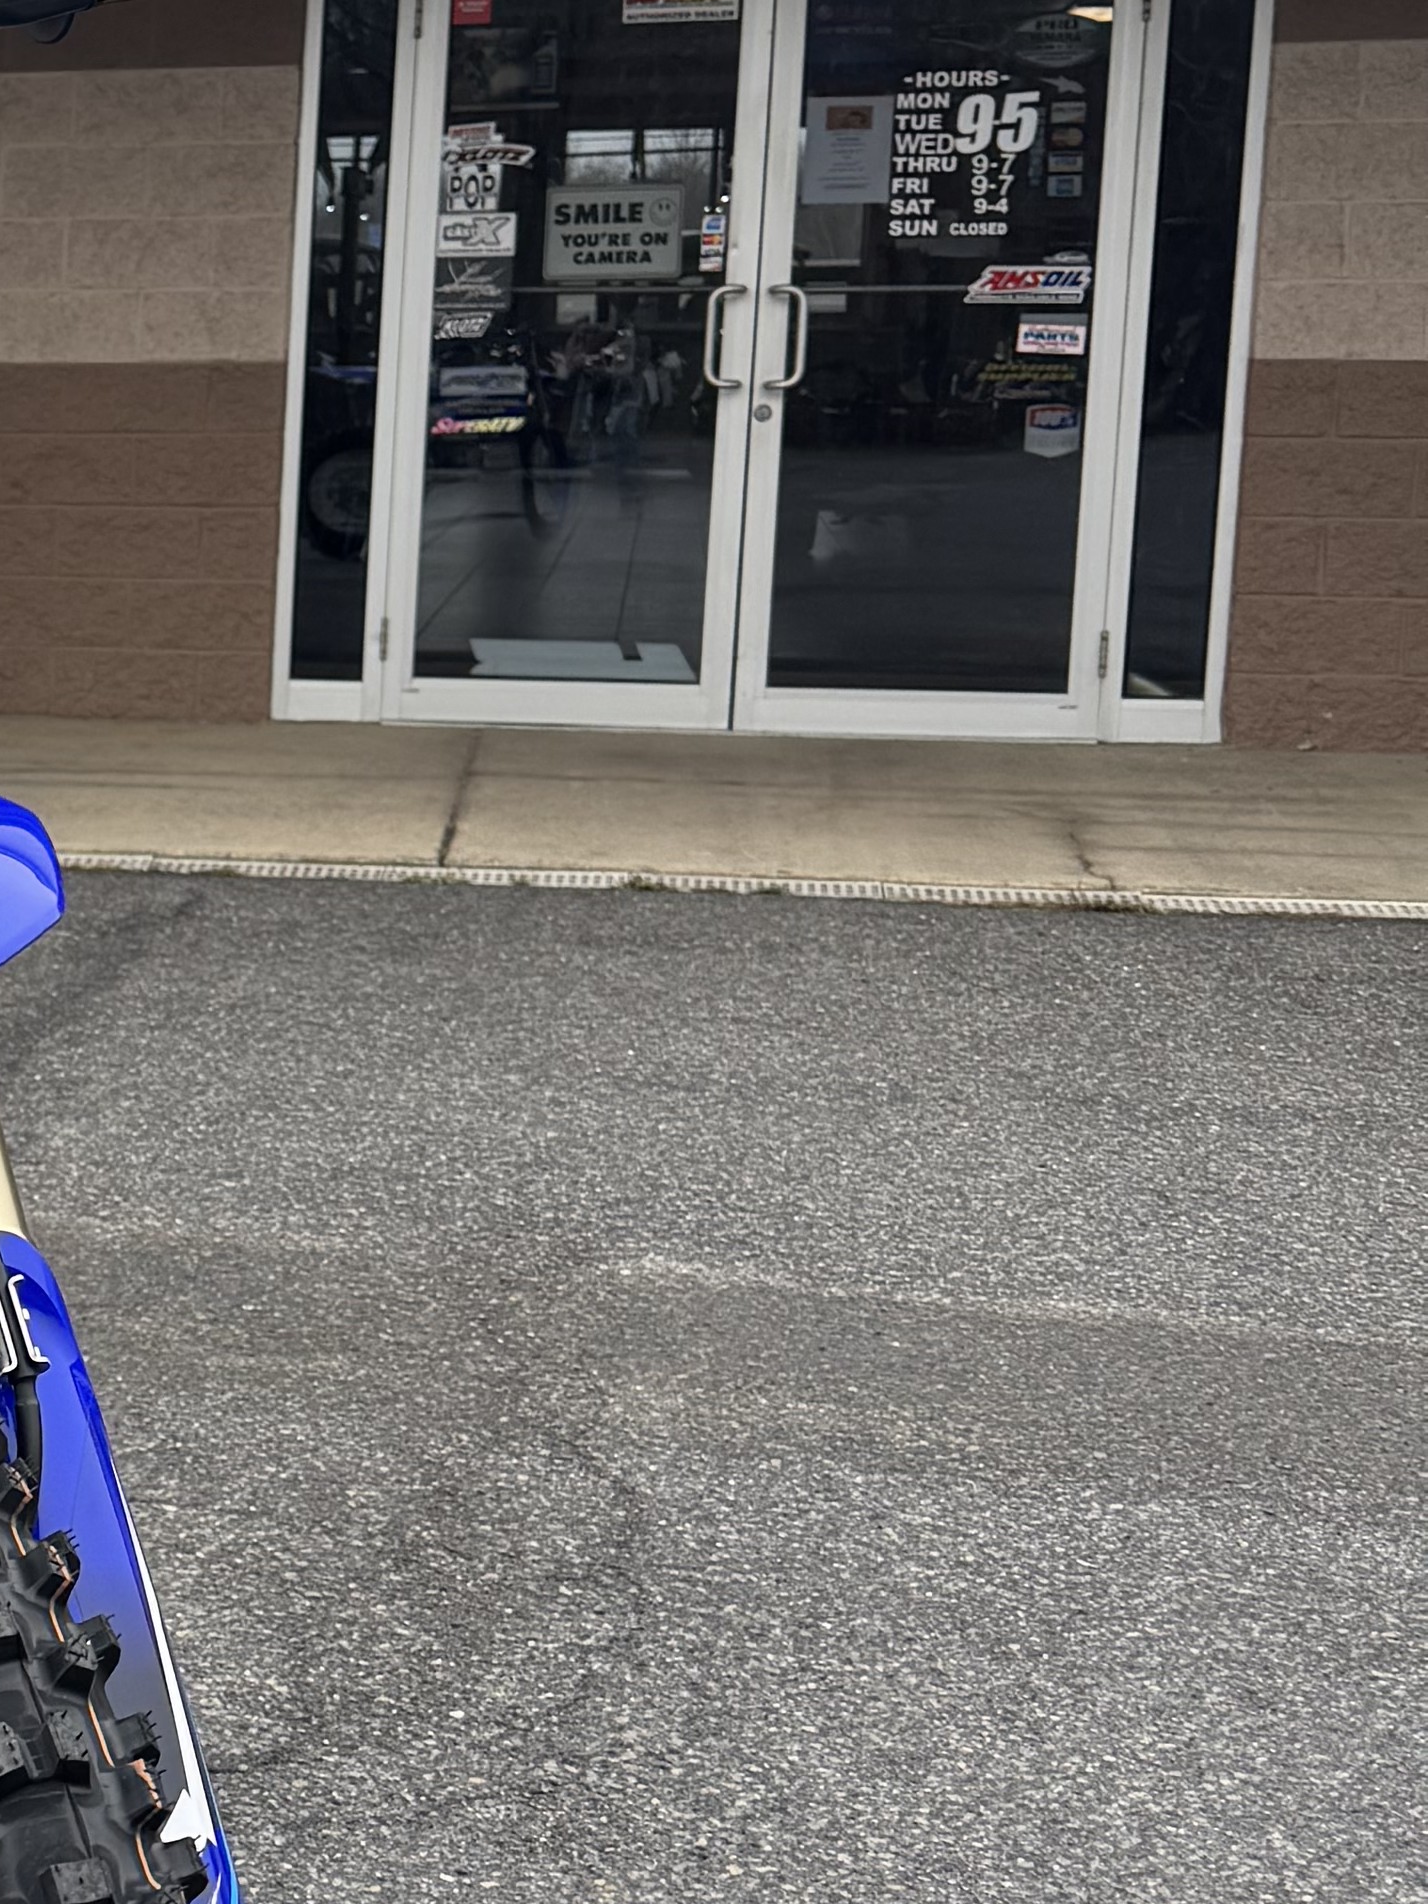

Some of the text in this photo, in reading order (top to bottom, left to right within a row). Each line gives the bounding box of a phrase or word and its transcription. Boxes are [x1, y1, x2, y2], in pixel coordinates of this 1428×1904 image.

[896, 92, 950, 109] MON
[895, 114, 943, 130] TUE
[895, 133, 956, 155] WED
[892, 153, 1016, 175] THRU 9-7
[891, 174, 1014, 196] FRI 9-7
[553, 201, 644, 226] SMILE
[889, 197, 1009, 215] SAT 9-4
[888, 219, 1008, 236] SUN CLOSED
[560, 232, 669, 248] YOU'RE ON
[572, 250, 652, 265] CAMERA
[980, 270, 1085, 291] AMSOIL
